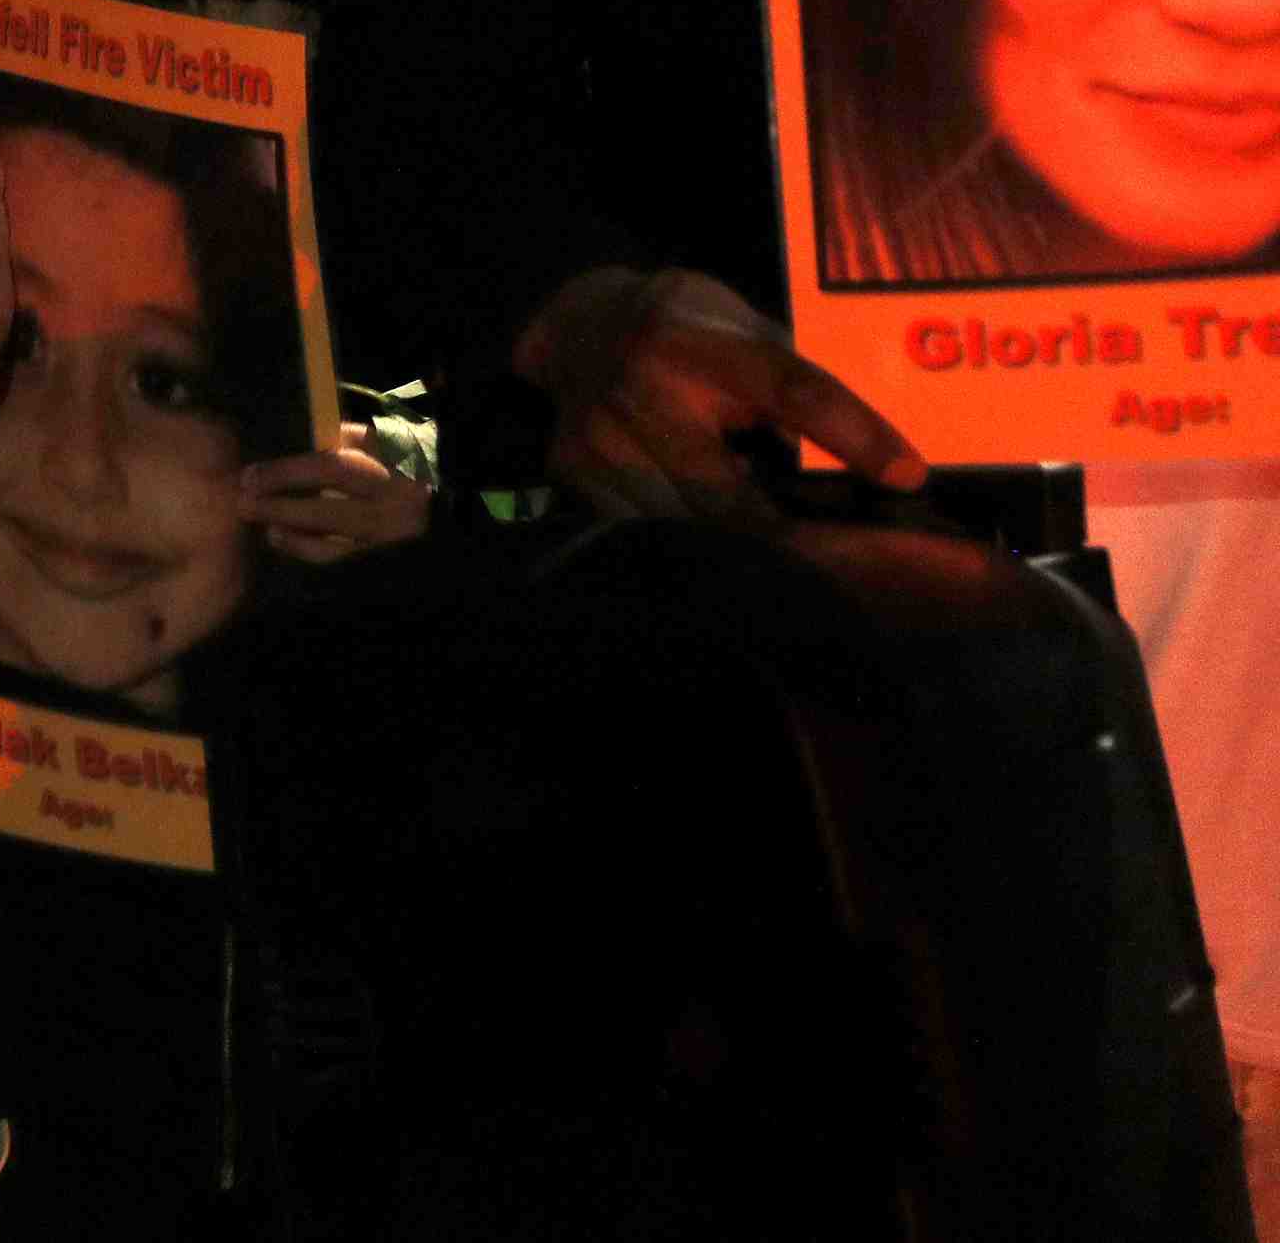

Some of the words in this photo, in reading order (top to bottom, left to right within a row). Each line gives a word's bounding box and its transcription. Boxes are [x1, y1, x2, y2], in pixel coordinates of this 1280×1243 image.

[59, 11, 127, 79] Fire
[139, 34, 275, 109] Victim
[905, 311, 1143, 372] Gloria
[1112, 390, 1232, 435] Age:
